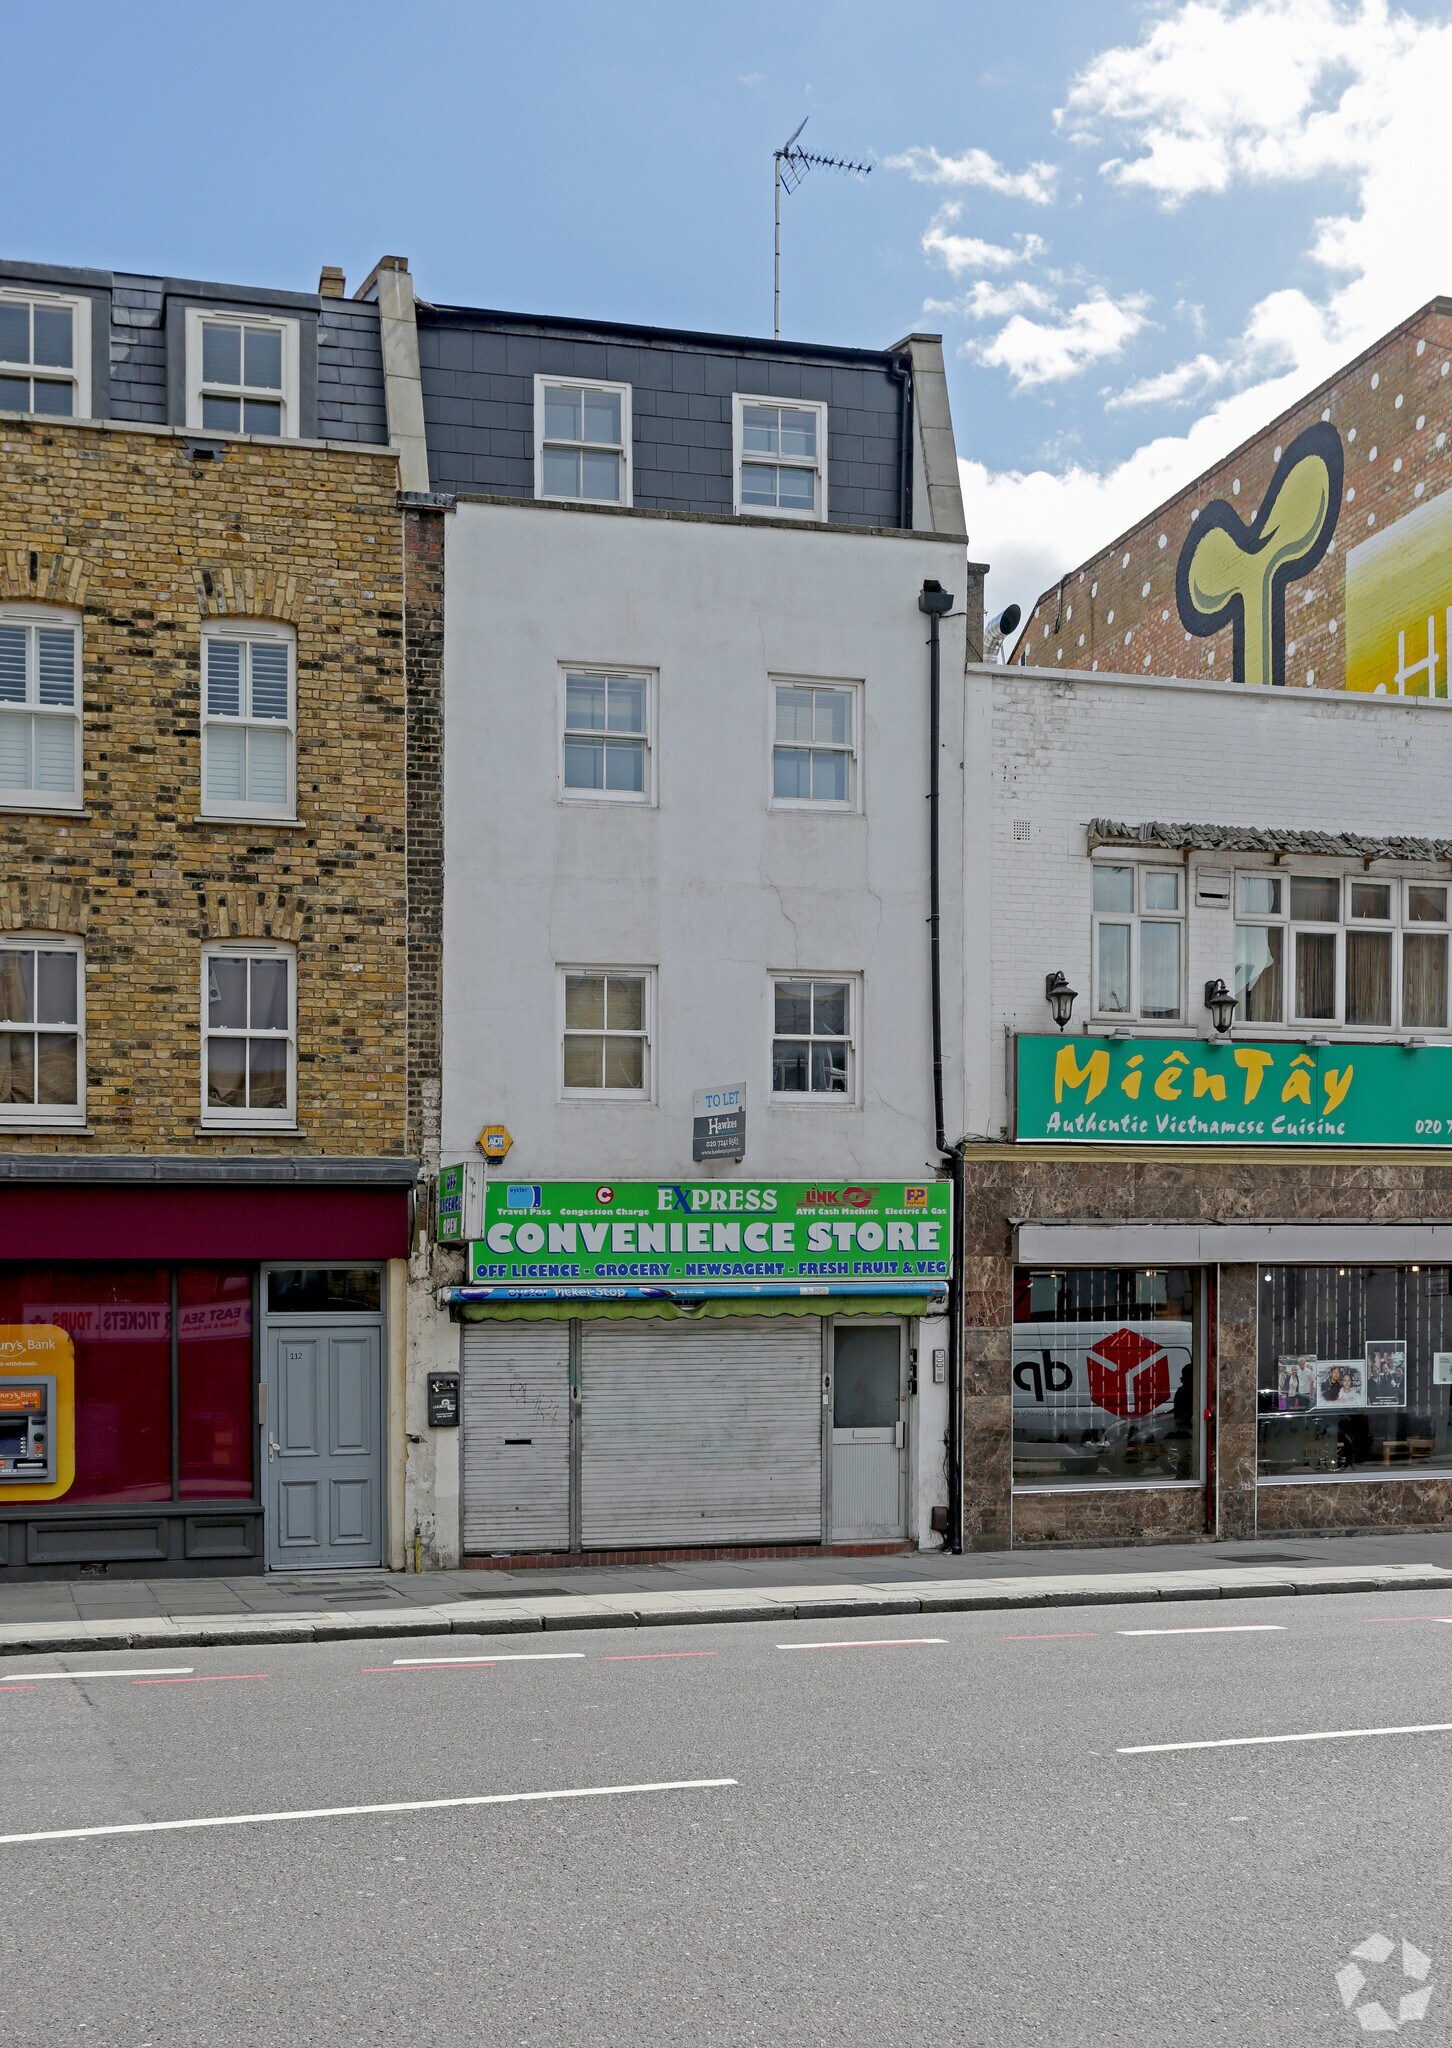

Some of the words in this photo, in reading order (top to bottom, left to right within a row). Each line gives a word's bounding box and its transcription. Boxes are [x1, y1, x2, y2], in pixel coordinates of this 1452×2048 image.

[706, 1094, 720, 1108] TO
[723, 1091, 740, 1106] LET
[708, 1117, 738, 1135] Hawkes
[1046, 1112, 1148, 1134] Authentic
[1156, 1114, 1264, 1134] Vietnamese
[1271, 1115, 1345, 1135] Cuisine
[1415, 1119, 1442, 1134] 020
[488, 1137, 504, 1146] ADT
[446, 1173, 457, 1191] OFF
[440, 1193, 463, 1215] LICENCE
[657, 1185, 778, 1214] EXPRESS
[497, 1208, 527, 1216] Travel
[529, 1208, 552, 1216] Pass
[560, 1208, 614, 1217] Congestion
[616, 1208, 650, 1217] Charge
[796, 1208, 816, 1216] ATM
[818, 1208, 840, 1216] Cash
[841, 1207, 879, 1216] Machine
[885, 1207, 920, 1215] Electric
[922, 1207, 928, 1215] &
[930, 1207, 947, 1215] Gas
[443, 1217, 458, 1235] OPEN
[486, 1222, 795, 1254] CONVENIENCE
[807, 1221, 942, 1253] STORE
[476, 1264, 506, 1278] OFF
[511, 1264, 580, 1277] LICENCE
[595, 1263, 671, 1277] GROCERY
[685, 1262, 785, 1276] NEWSAGENT
[798, 1262, 849, 1275] FRESH
[853, 1261, 898, 1275] FRUIT
[902, 1261, 914, 1274] &
[916, 1261, 946, 1274] VEG
[508, 1288, 548, 1299] oyster
[596, 1287, 626, 1298] Stop
[27, 1339, 56, 1350] Bank
[290, 1352, 303, 1360] 112
[20, 1390, 38, 1398] Bank
